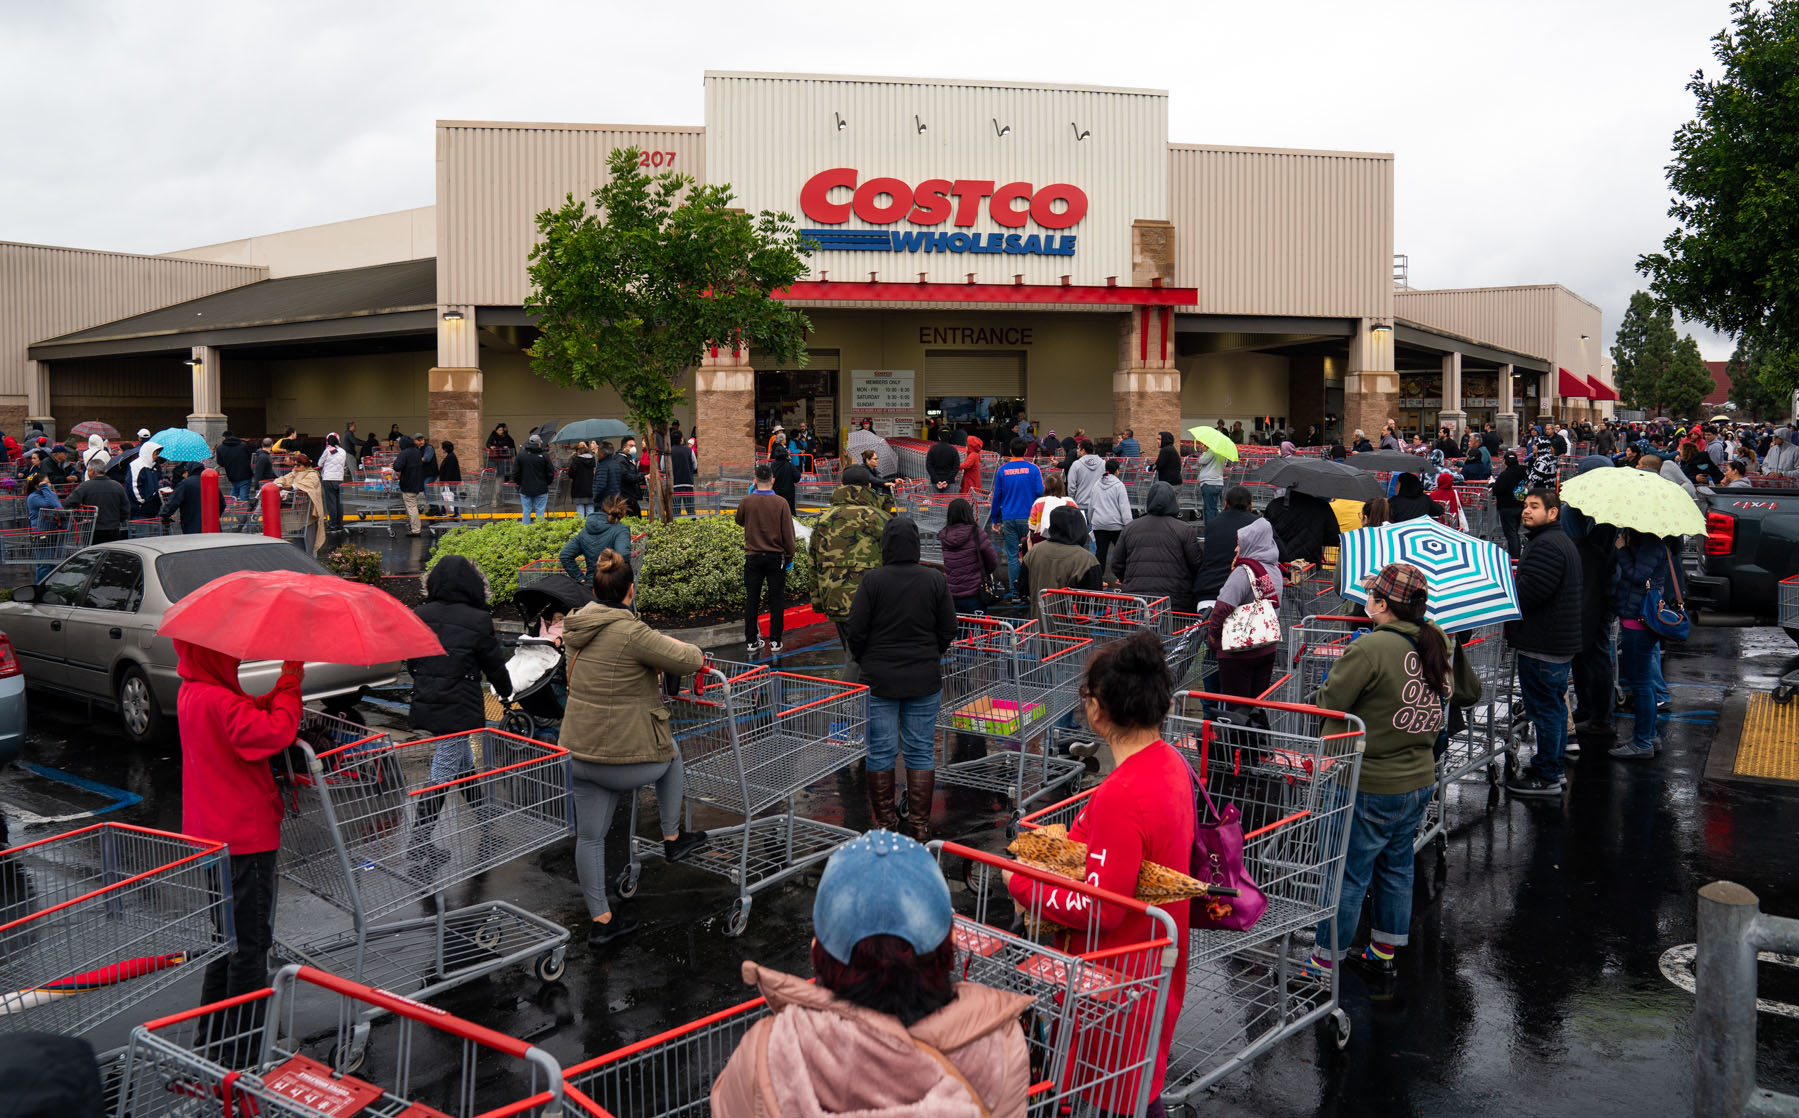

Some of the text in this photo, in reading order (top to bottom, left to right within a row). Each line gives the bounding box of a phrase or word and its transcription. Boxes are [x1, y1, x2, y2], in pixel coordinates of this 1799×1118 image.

[629, 150, 677, 167] 207
[800, 168, 1089, 229] COSTCO
[890, 230, 1077, 256] WHOLESALE
[919, 326, 1033, 345] ENTRANCE
